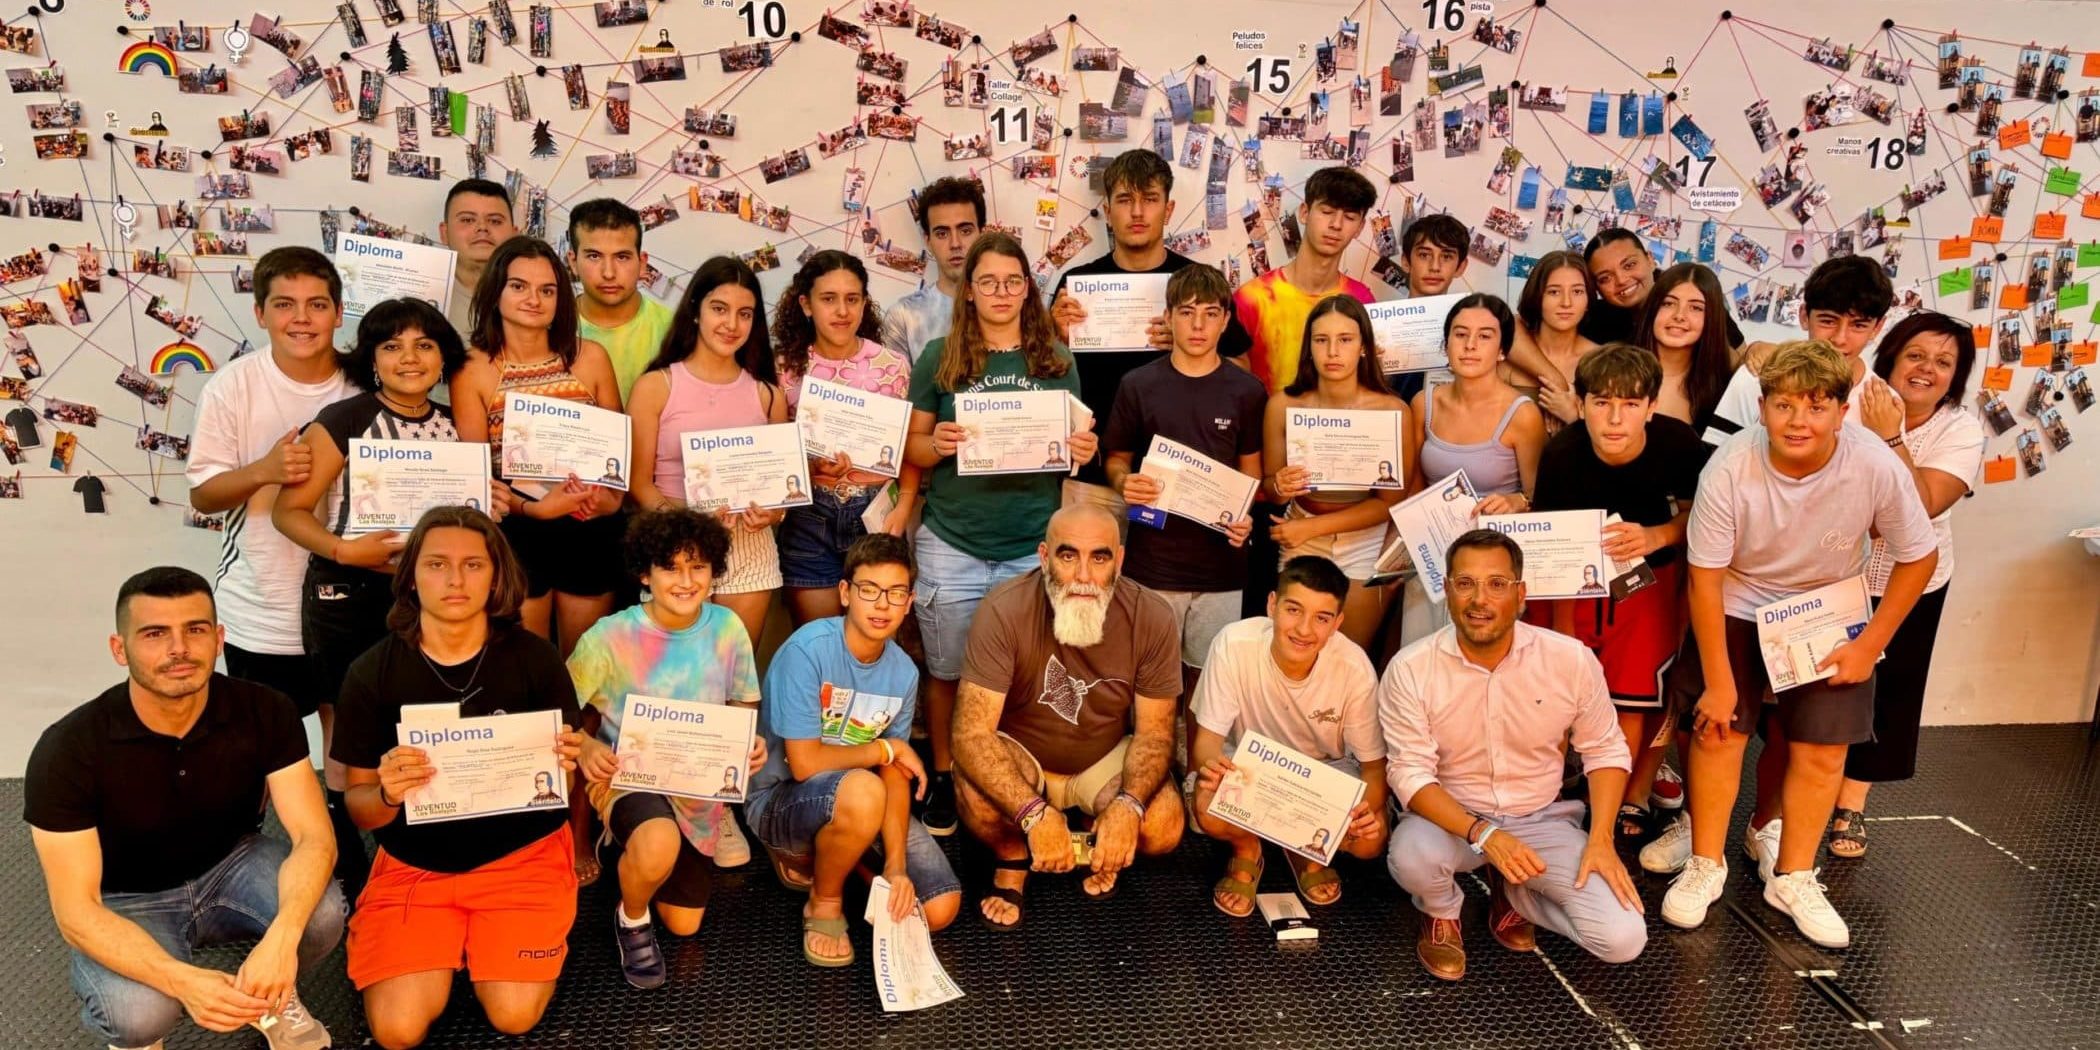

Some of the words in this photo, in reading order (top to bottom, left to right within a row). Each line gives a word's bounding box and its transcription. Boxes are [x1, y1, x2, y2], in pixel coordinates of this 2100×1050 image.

[1470, 2, 1491, 11] pista
[738, 1, 786, 38] 10
[1423, 0, 1465, 31] 16
[1232, 31, 1265, 40] Peludos
[1236, 41, 1263, 49] felices
[1247, 58, 1290, 94] 15
[988, 81, 1010, 89] Taller
[991, 92, 1023, 102] Collage
[990, 107, 1027, 142] 11
[1867, 137, 1905, 170] 18
[1675, 155, 1717, 187] 17
[1690, 190, 1739, 198] Avistamiento
[344, 239, 403, 259] Diploma
[1074, 281, 1129, 295] Diploma
[1369, 305, 1426, 320] Diploma
[984, 373, 1016, 387] Court
[1017, 376, 1031, 390] de
[808, 383, 865, 407] Diploma
[514, 399, 581, 420] Diploma
[963, 399, 1023, 413] Diploma
[1293, 414, 1351, 429] Diploma
[690, 435, 754, 452] Diploma
[359, 445, 433, 462] Diploma
[1157, 442, 1212, 474] Diploma
[508, 462, 543, 470] JUVENTUD
[1487, 521, 1552, 535] Diploma
[1418, 543, 1443, 594] Diploma
[1764, 598, 1823, 624] Diploma
[633, 702, 705, 724] Diploma
[409, 728, 494, 746] Diploma
[1247, 739, 1312, 779] Diploma
[619, 771, 657, 781] JUVENTUD
[412, 802, 457, 813] JUVENTUD
[1217, 800, 1251, 819] JUVENTUD
[879, 938, 898, 1003] Diploma
